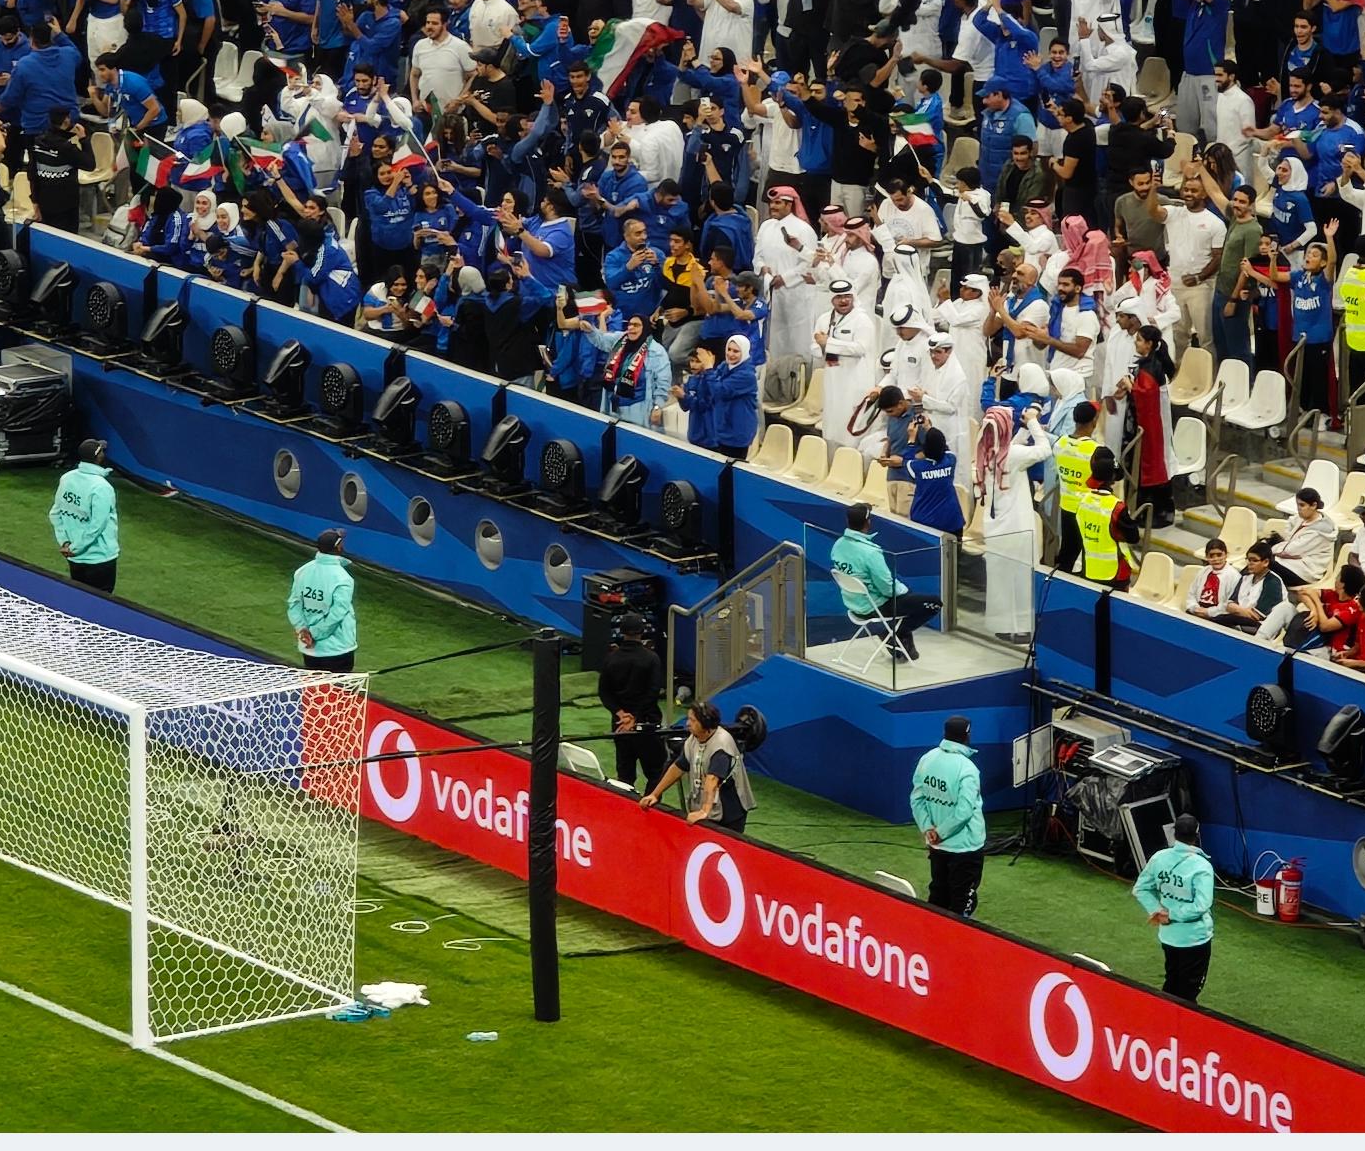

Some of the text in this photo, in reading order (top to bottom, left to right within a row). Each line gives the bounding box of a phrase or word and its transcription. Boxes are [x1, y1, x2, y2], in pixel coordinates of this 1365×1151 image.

[921, 467, 952, 480] KUWAIT
[431, 770, 593, 867] vodafne
[924, 776, 947, 792] 4018
[755, 893, 930, 997] vodafone
[1105, 1026, 1294, 1134] vodafone
